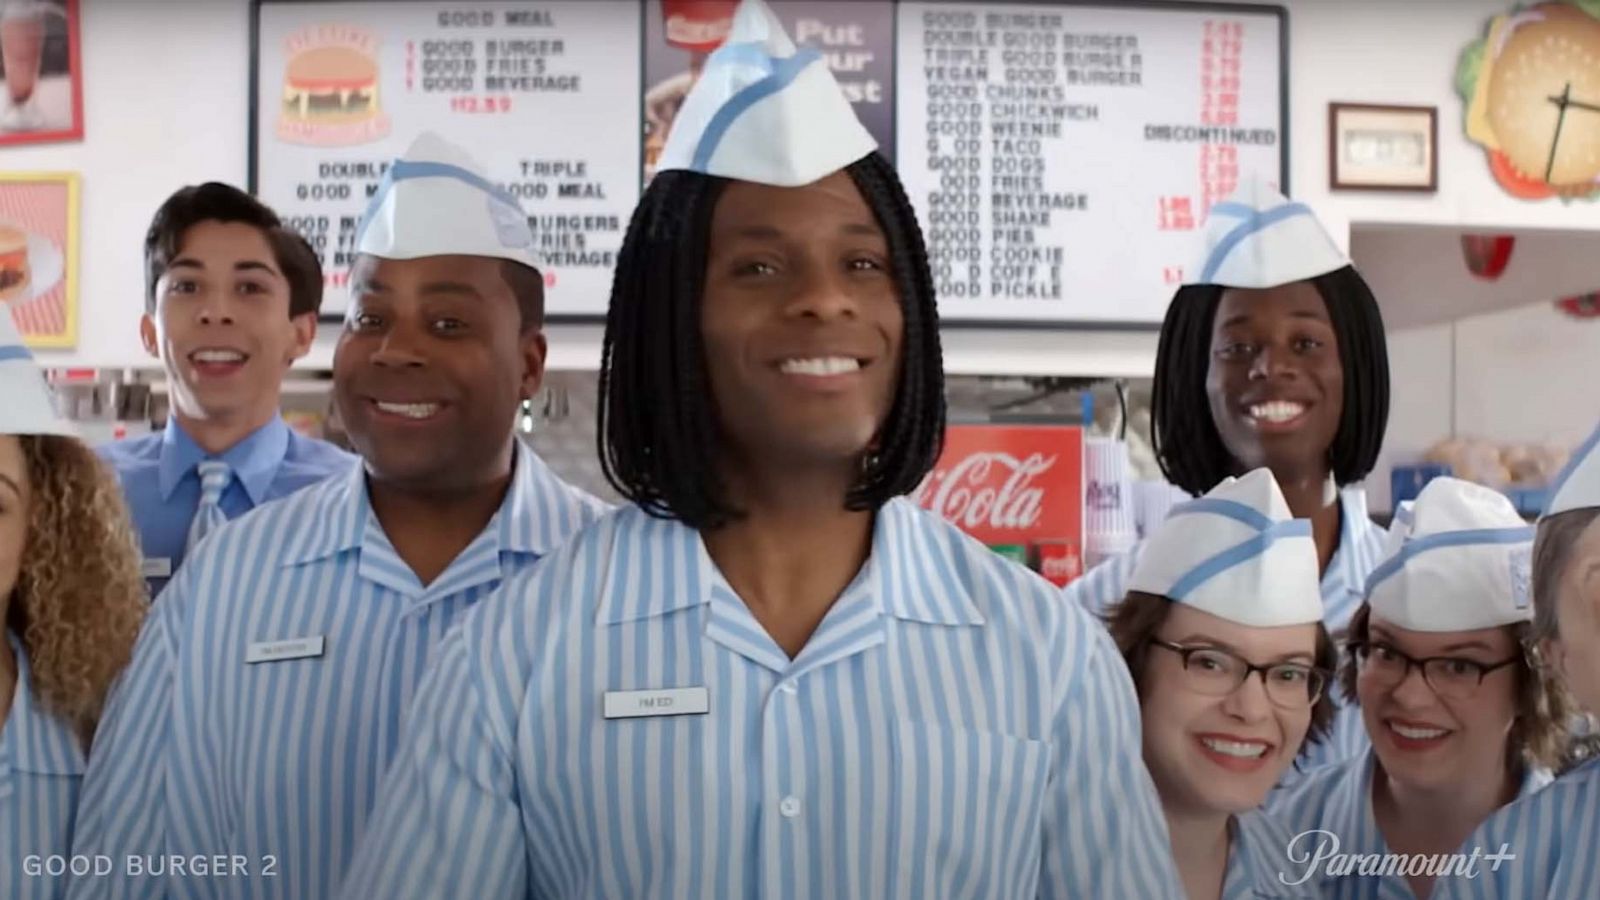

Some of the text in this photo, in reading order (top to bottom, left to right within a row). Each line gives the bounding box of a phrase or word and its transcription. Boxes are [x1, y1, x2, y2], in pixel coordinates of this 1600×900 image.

[438, 11, 555, 27] GOOD MEAL
[923, 12, 1063, 28] GOOD BURGER
[796, 20, 863, 45] Put
[923, 31, 1138, 48] DOUBLE GOOD BURGER
[422, 41, 474, 56] GOOD
[486, 41, 564, 55] BURGER
[924, 49, 988, 65] TRIPLE
[1002, 50, 1056, 66] GOOD
[422, 59, 476, 74] GOOD
[486, 59, 546, 74] FRIES
[422, 77, 473, 92] GOOD
[485, 76, 580, 92] BEVERAGE
[924, 66, 1142, 86] VEGAN GOOD BURGER
[927, 85, 1065, 101] GOOD CHUNKS
[927, 102, 1098, 120] GOOD CHICKWICH
[926, 121, 1061, 138] GOOD WEENIE
[1144, 126, 1276, 145] DISCONTINUED
[992, 139, 1040, 154] TACO
[520, 161, 586, 178] TRIPLE
[928, 156, 1045, 173] GOOD DOGS
[508, 183, 606, 199] OOD MEAL
[992, 176, 1042, 191] FRIES
[297, 184, 350, 200] GOOD
[928, 192, 1088, 210] GOOD BEVERAGE
[929, 211, 1050, 227] GOOD SHAKE
[538, 233, 585, 249] RIES
[929, 229, 1034, 244] GOOD PIES
[991, 248, 1063, 264] COOKIE
[941, 281, 1063, 299] OOD PICKLE
